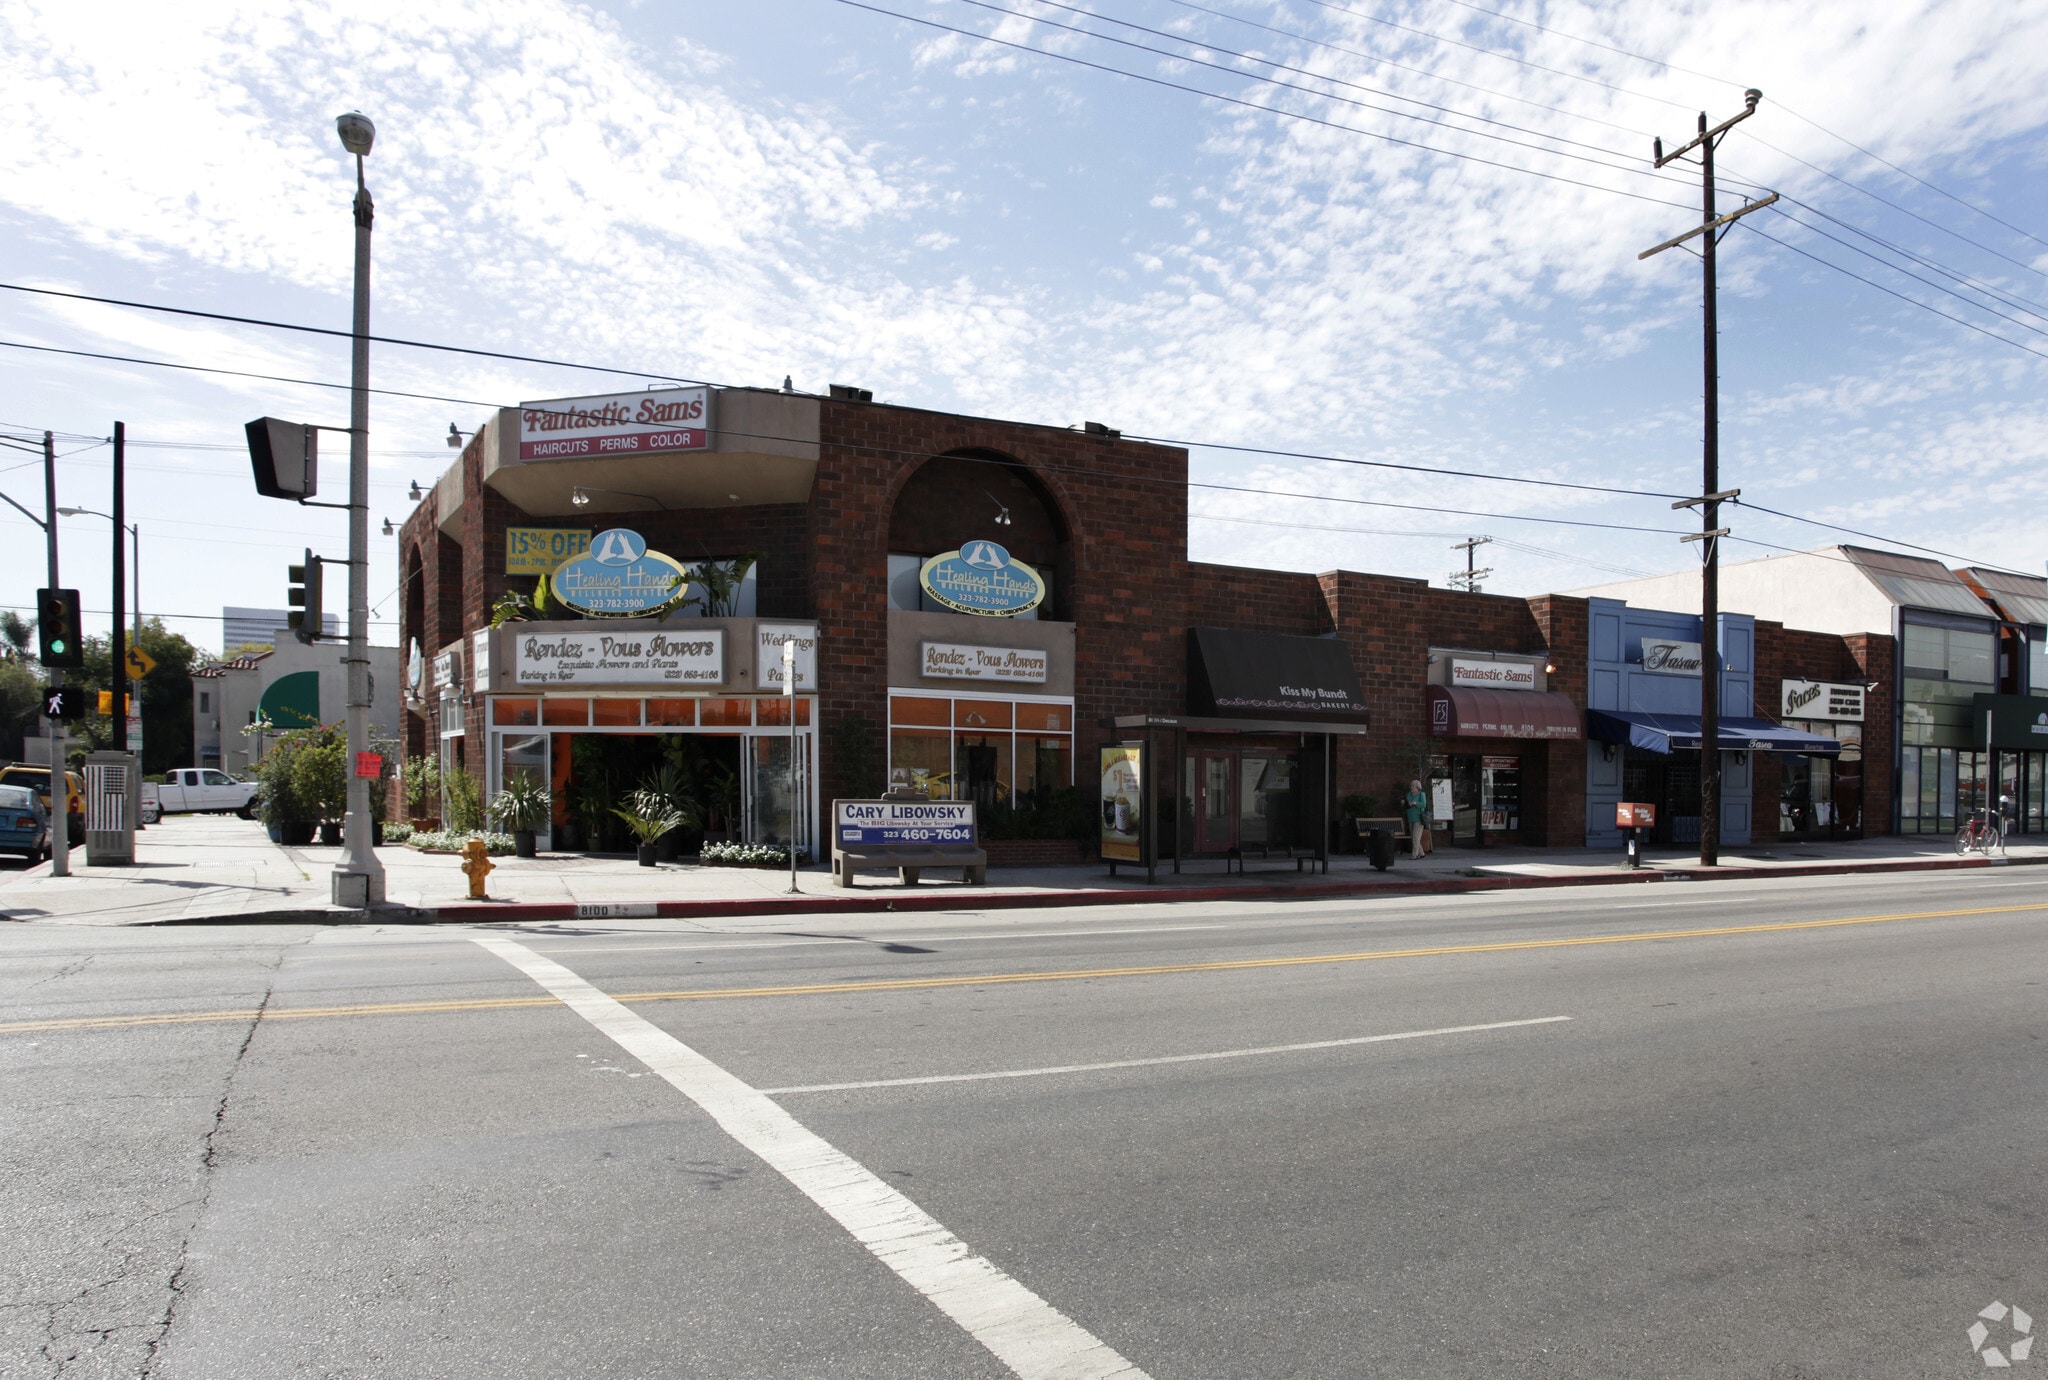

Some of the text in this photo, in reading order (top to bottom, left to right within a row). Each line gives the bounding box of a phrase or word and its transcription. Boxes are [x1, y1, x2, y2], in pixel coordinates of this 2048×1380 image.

[523, 398, 703, 432] Fantastic Sams
[533, 433, 691, 456] HAIRCUTS PERMS COLOR
[510, 531, 588, 555] 15% OFF
[566, 566, 622, 591] Healing
[936, 562, 1038, 591] Healing Hands
[571, 589, 622, 597] WELLNESS
[941, 583, 1030, 599] WELLNESS CENTER
[589, 598, 645, 608] 323-782-3900
[926, 586, 1037, 616] MASSAGE ACUPUNCTURE CHIROPRACTIC
[958, 594, 1009, 606] 323-782-3900
[524, 636, 583, 661] Rendez
[600, 636, 641, 658] Vous
[646, 634, 714, 658] Flowers
[557, 659, 678, 671] Exquisite Flowers and Plants
[927, 646, 966, 666] Rendez
[976, 650, 1002, 666] Vous
[1004, 650, 1044, 669] Flowers
[926, 665, 954, 676] Parking
[955, 667, 963, 675] in
[965, 667, 982, 676] Rear
[1453, 666, 1533, 682] Fantastic Sams
[1280, 686, 1348, 699] Kiss My Bundt
[846, 804, 966, 819] CARY LIBOWSKY
[1482, 811, 1505, 825] OPEN
[901, 829, 970, 840] 460-7604
[581, 905, 608, 916] 8100
